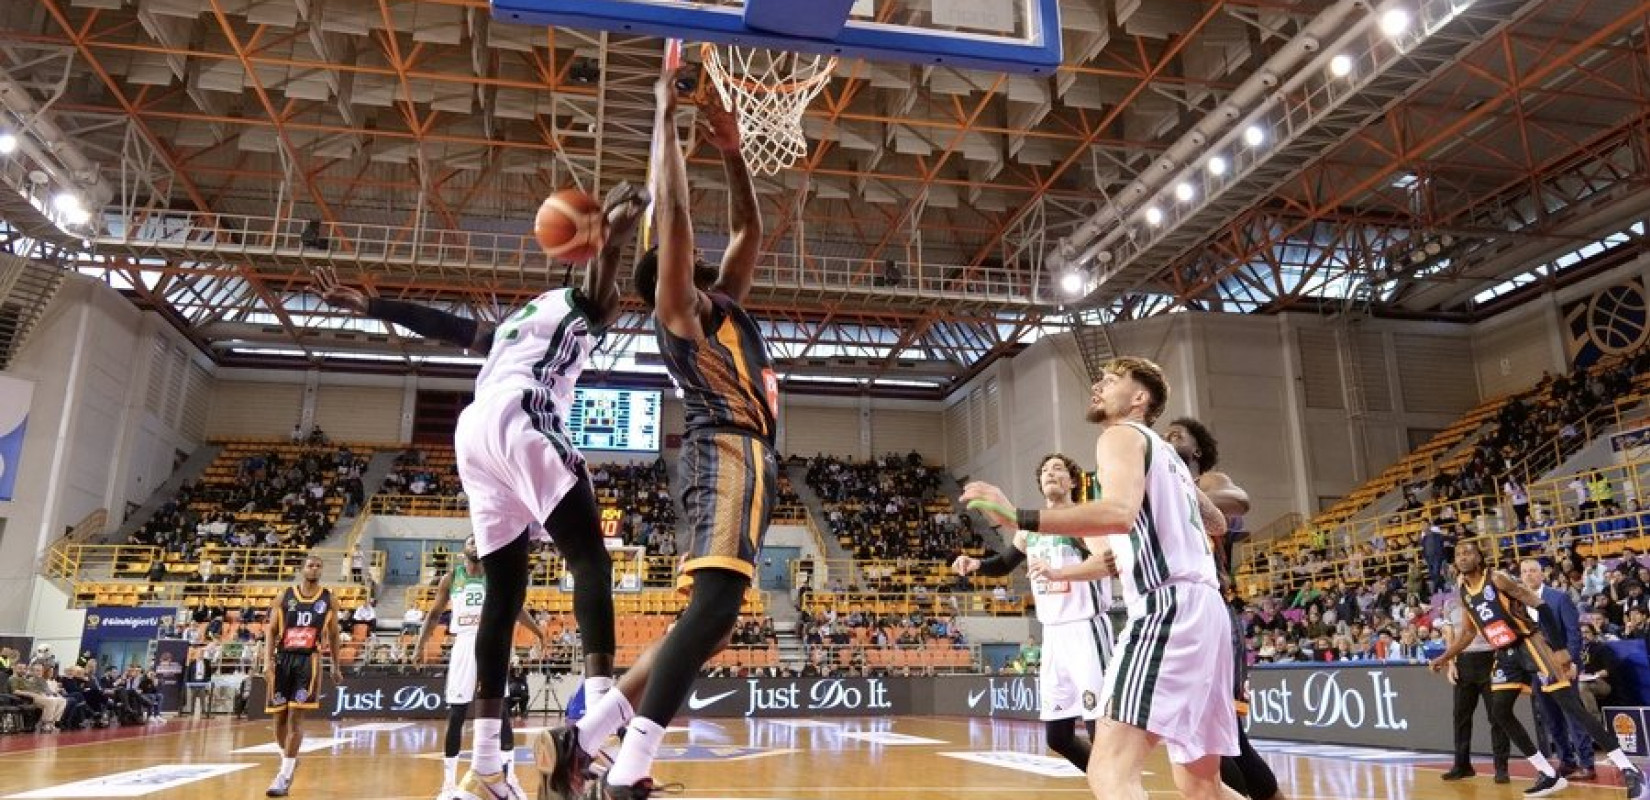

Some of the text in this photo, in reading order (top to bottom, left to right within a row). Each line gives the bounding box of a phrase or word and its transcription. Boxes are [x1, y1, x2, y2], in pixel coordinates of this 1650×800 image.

[465, 592, 483, 606] 22
[296, 611, 312, 627] 10
[331, 685, 441, 716] Just Do
[744, 678, 893, 717] Just Do It.
[988, 678, 1010, 716] Just
[1010, 677, 1034, 711] Do
[1303, 669, 1366, 729] Do
[1367, 670, 1408, 730] It.
